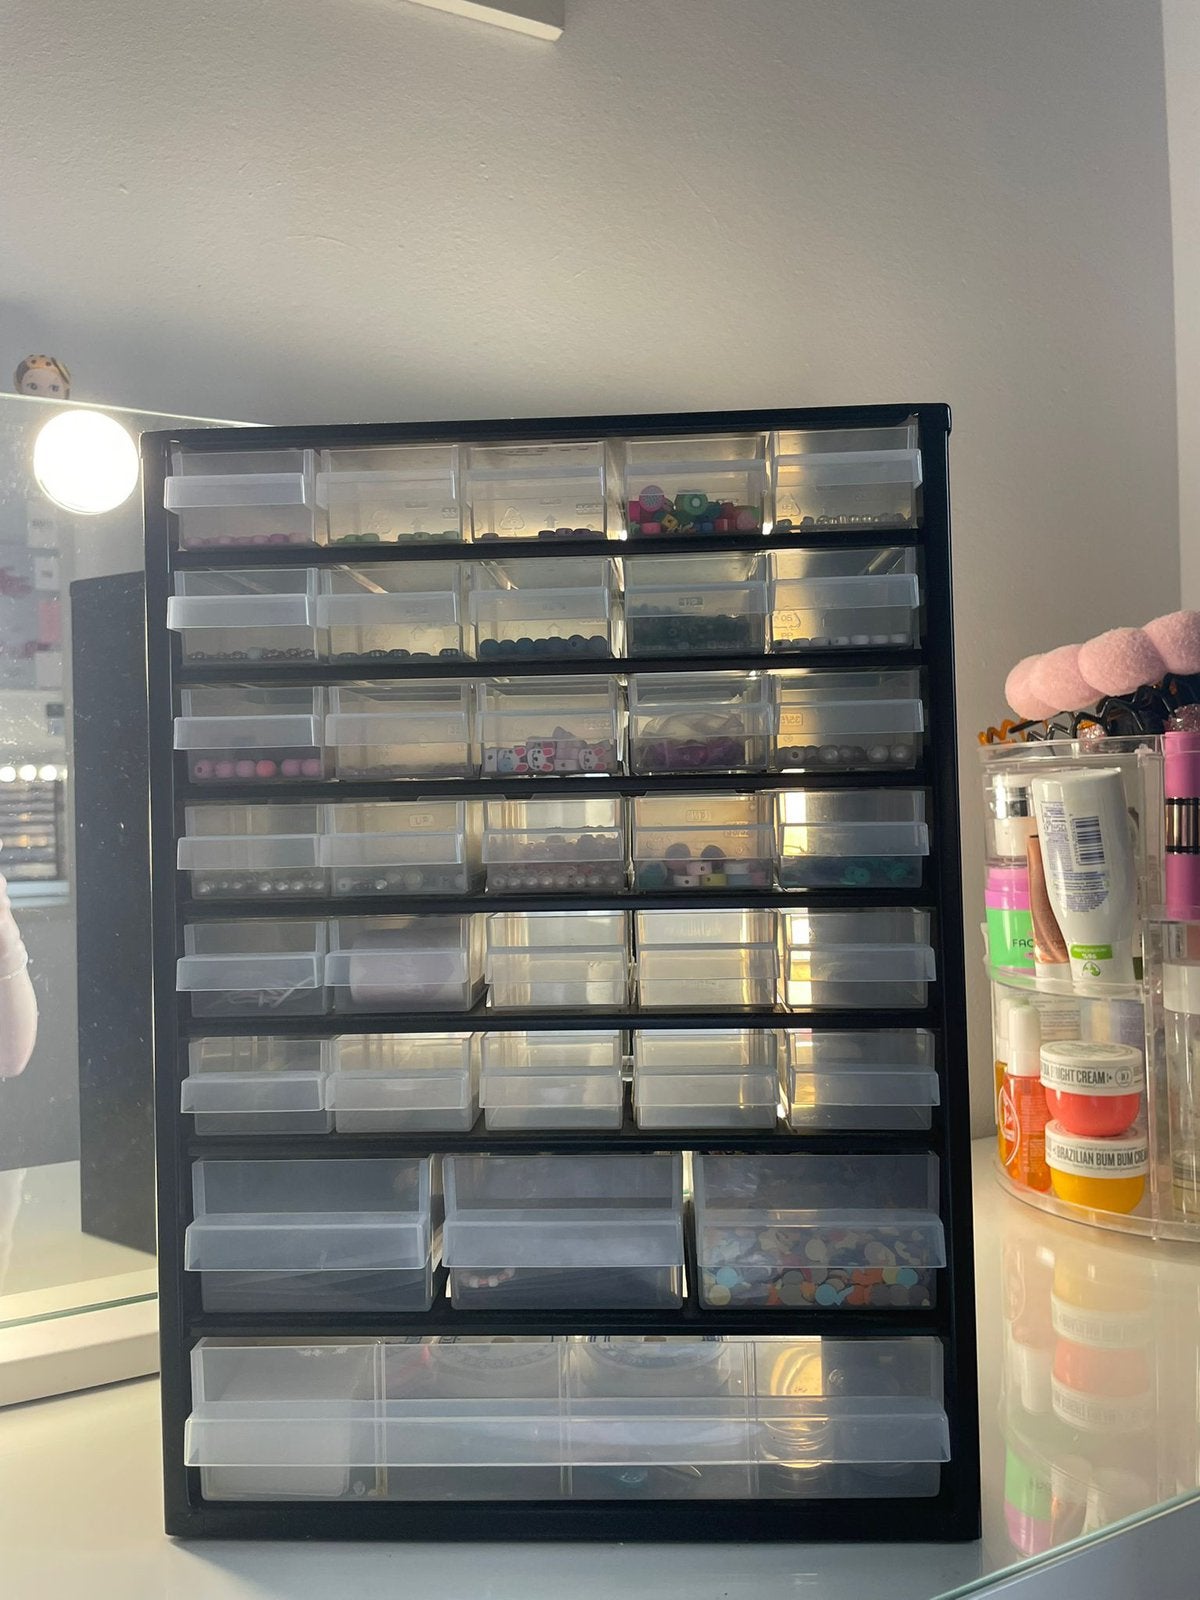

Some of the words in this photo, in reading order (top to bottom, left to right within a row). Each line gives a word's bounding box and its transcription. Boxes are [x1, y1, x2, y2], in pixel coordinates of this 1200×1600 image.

[1076, 1070, 1106, 1084] CREAM
[1057, 1145, 1094, 1165] BRAZILIAN
[1095, 1152, 1115, 1166] BUM
[1116, 1151, 1134, 1166] BUM
